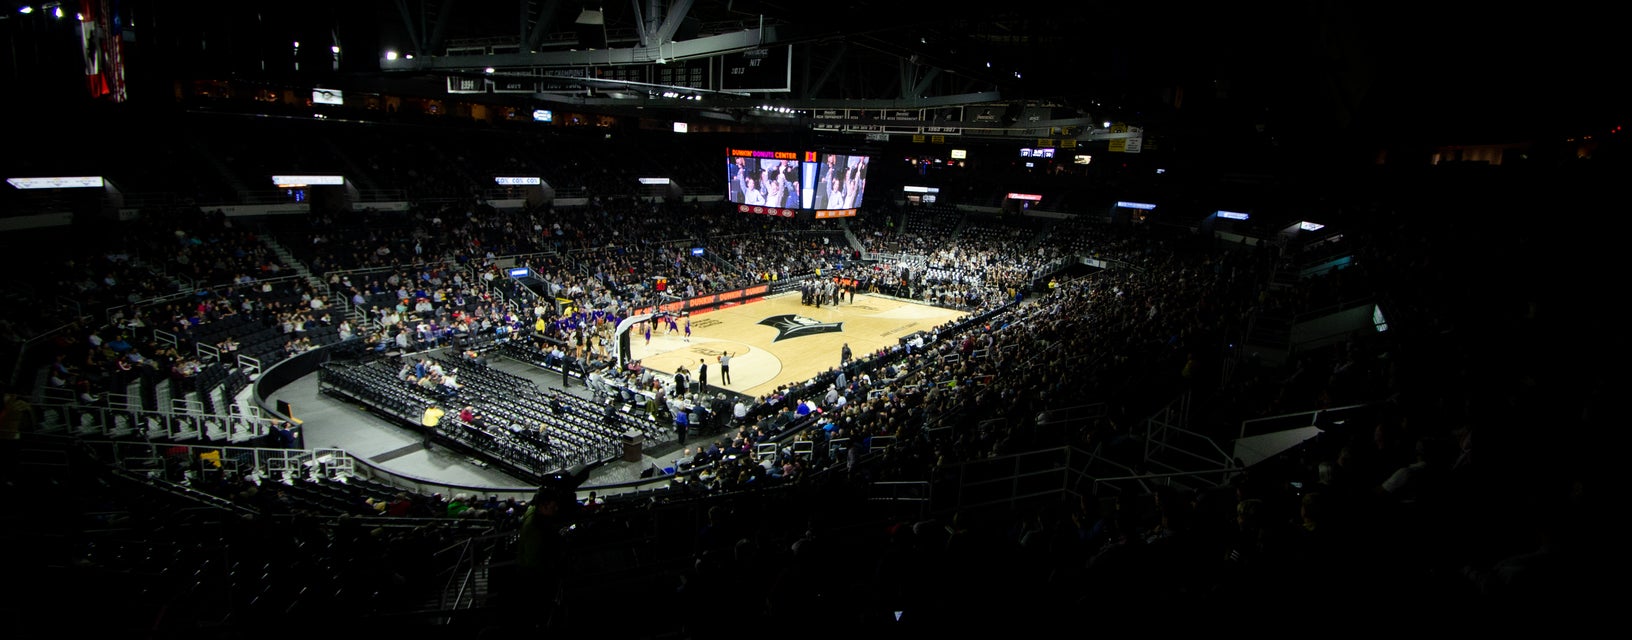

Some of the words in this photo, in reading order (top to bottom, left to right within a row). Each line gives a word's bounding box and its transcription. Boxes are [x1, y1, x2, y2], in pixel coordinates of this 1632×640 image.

[749, 59, 762, 67] NIT
[732, 149, 752, 157] DUNKIN'
[752, 150, 774, 158] DONUTS
[775, 151, 797, 159] CENTER
[690, 295, 716, 307] DUNKIN'
[719, 290, 743, 301] DUNKIN'
